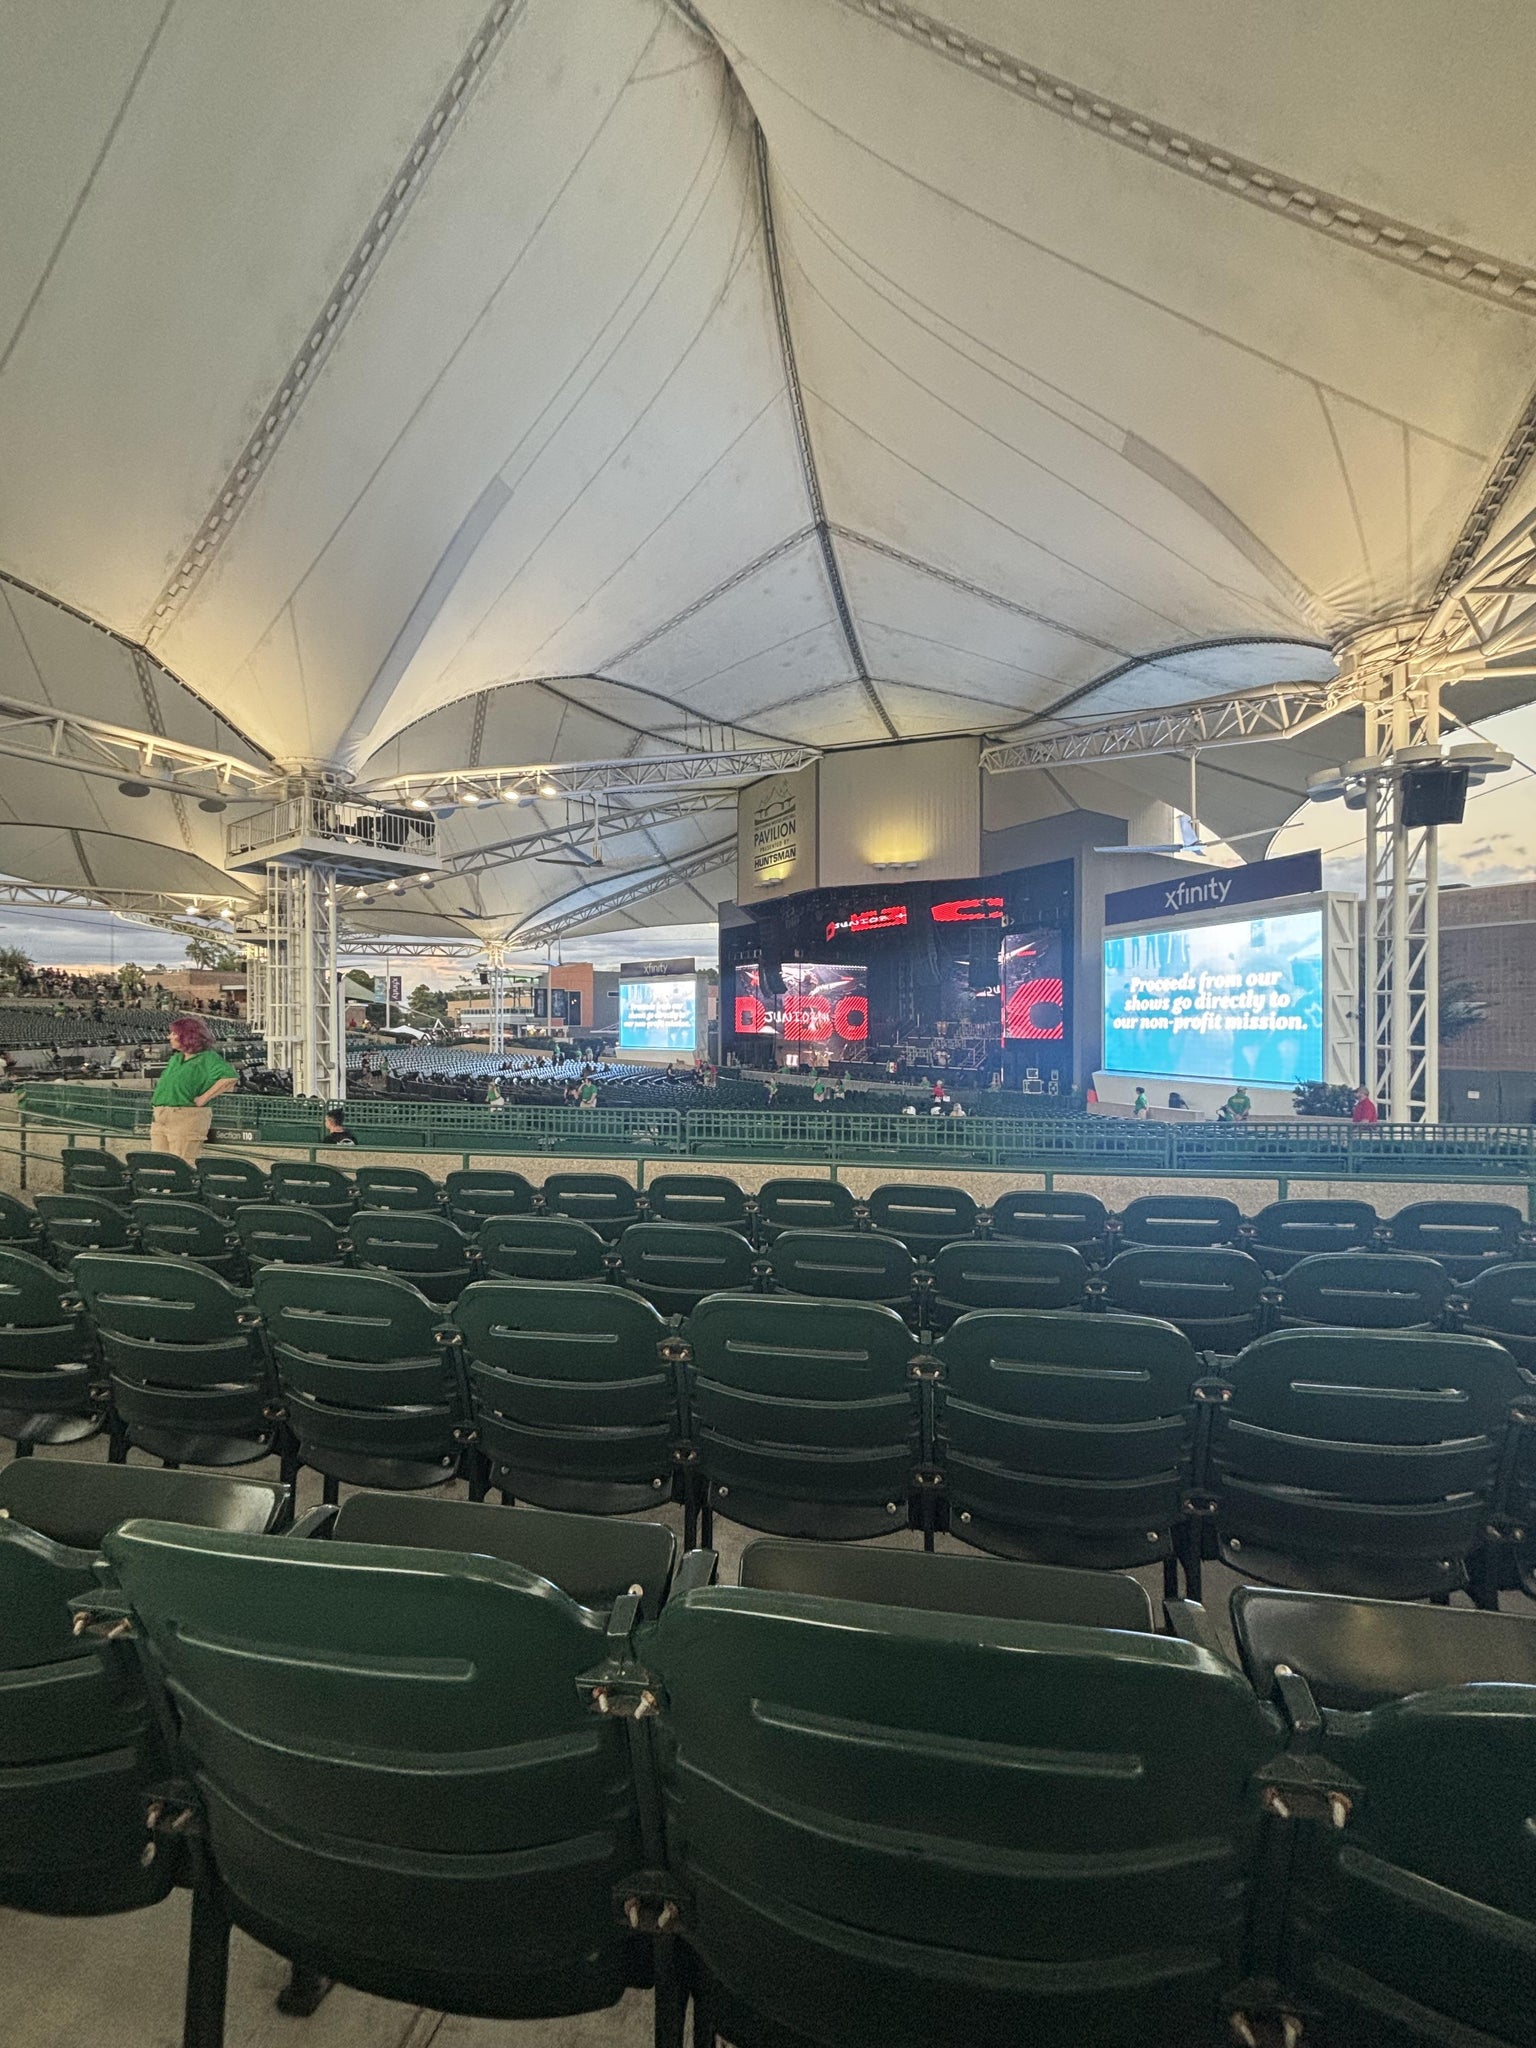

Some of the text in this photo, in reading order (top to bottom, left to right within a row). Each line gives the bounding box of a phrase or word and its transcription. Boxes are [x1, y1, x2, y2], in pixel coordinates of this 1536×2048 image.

[754, 819, 796, 847] PAVILION
[754, 847, 796, 869] HUNTSMAN
[1165, 877, 1232, 910] xfinity
[643, 963, 668, 975] xfinity
[1130, 971, 1283, 993] Proceeds from our
[1125, 989, 1291, 1014] shows go directly to
[1114, 1011, 1308, 1034] our non-profit mission.
[216, 1130, 253, 1141] Section 110
